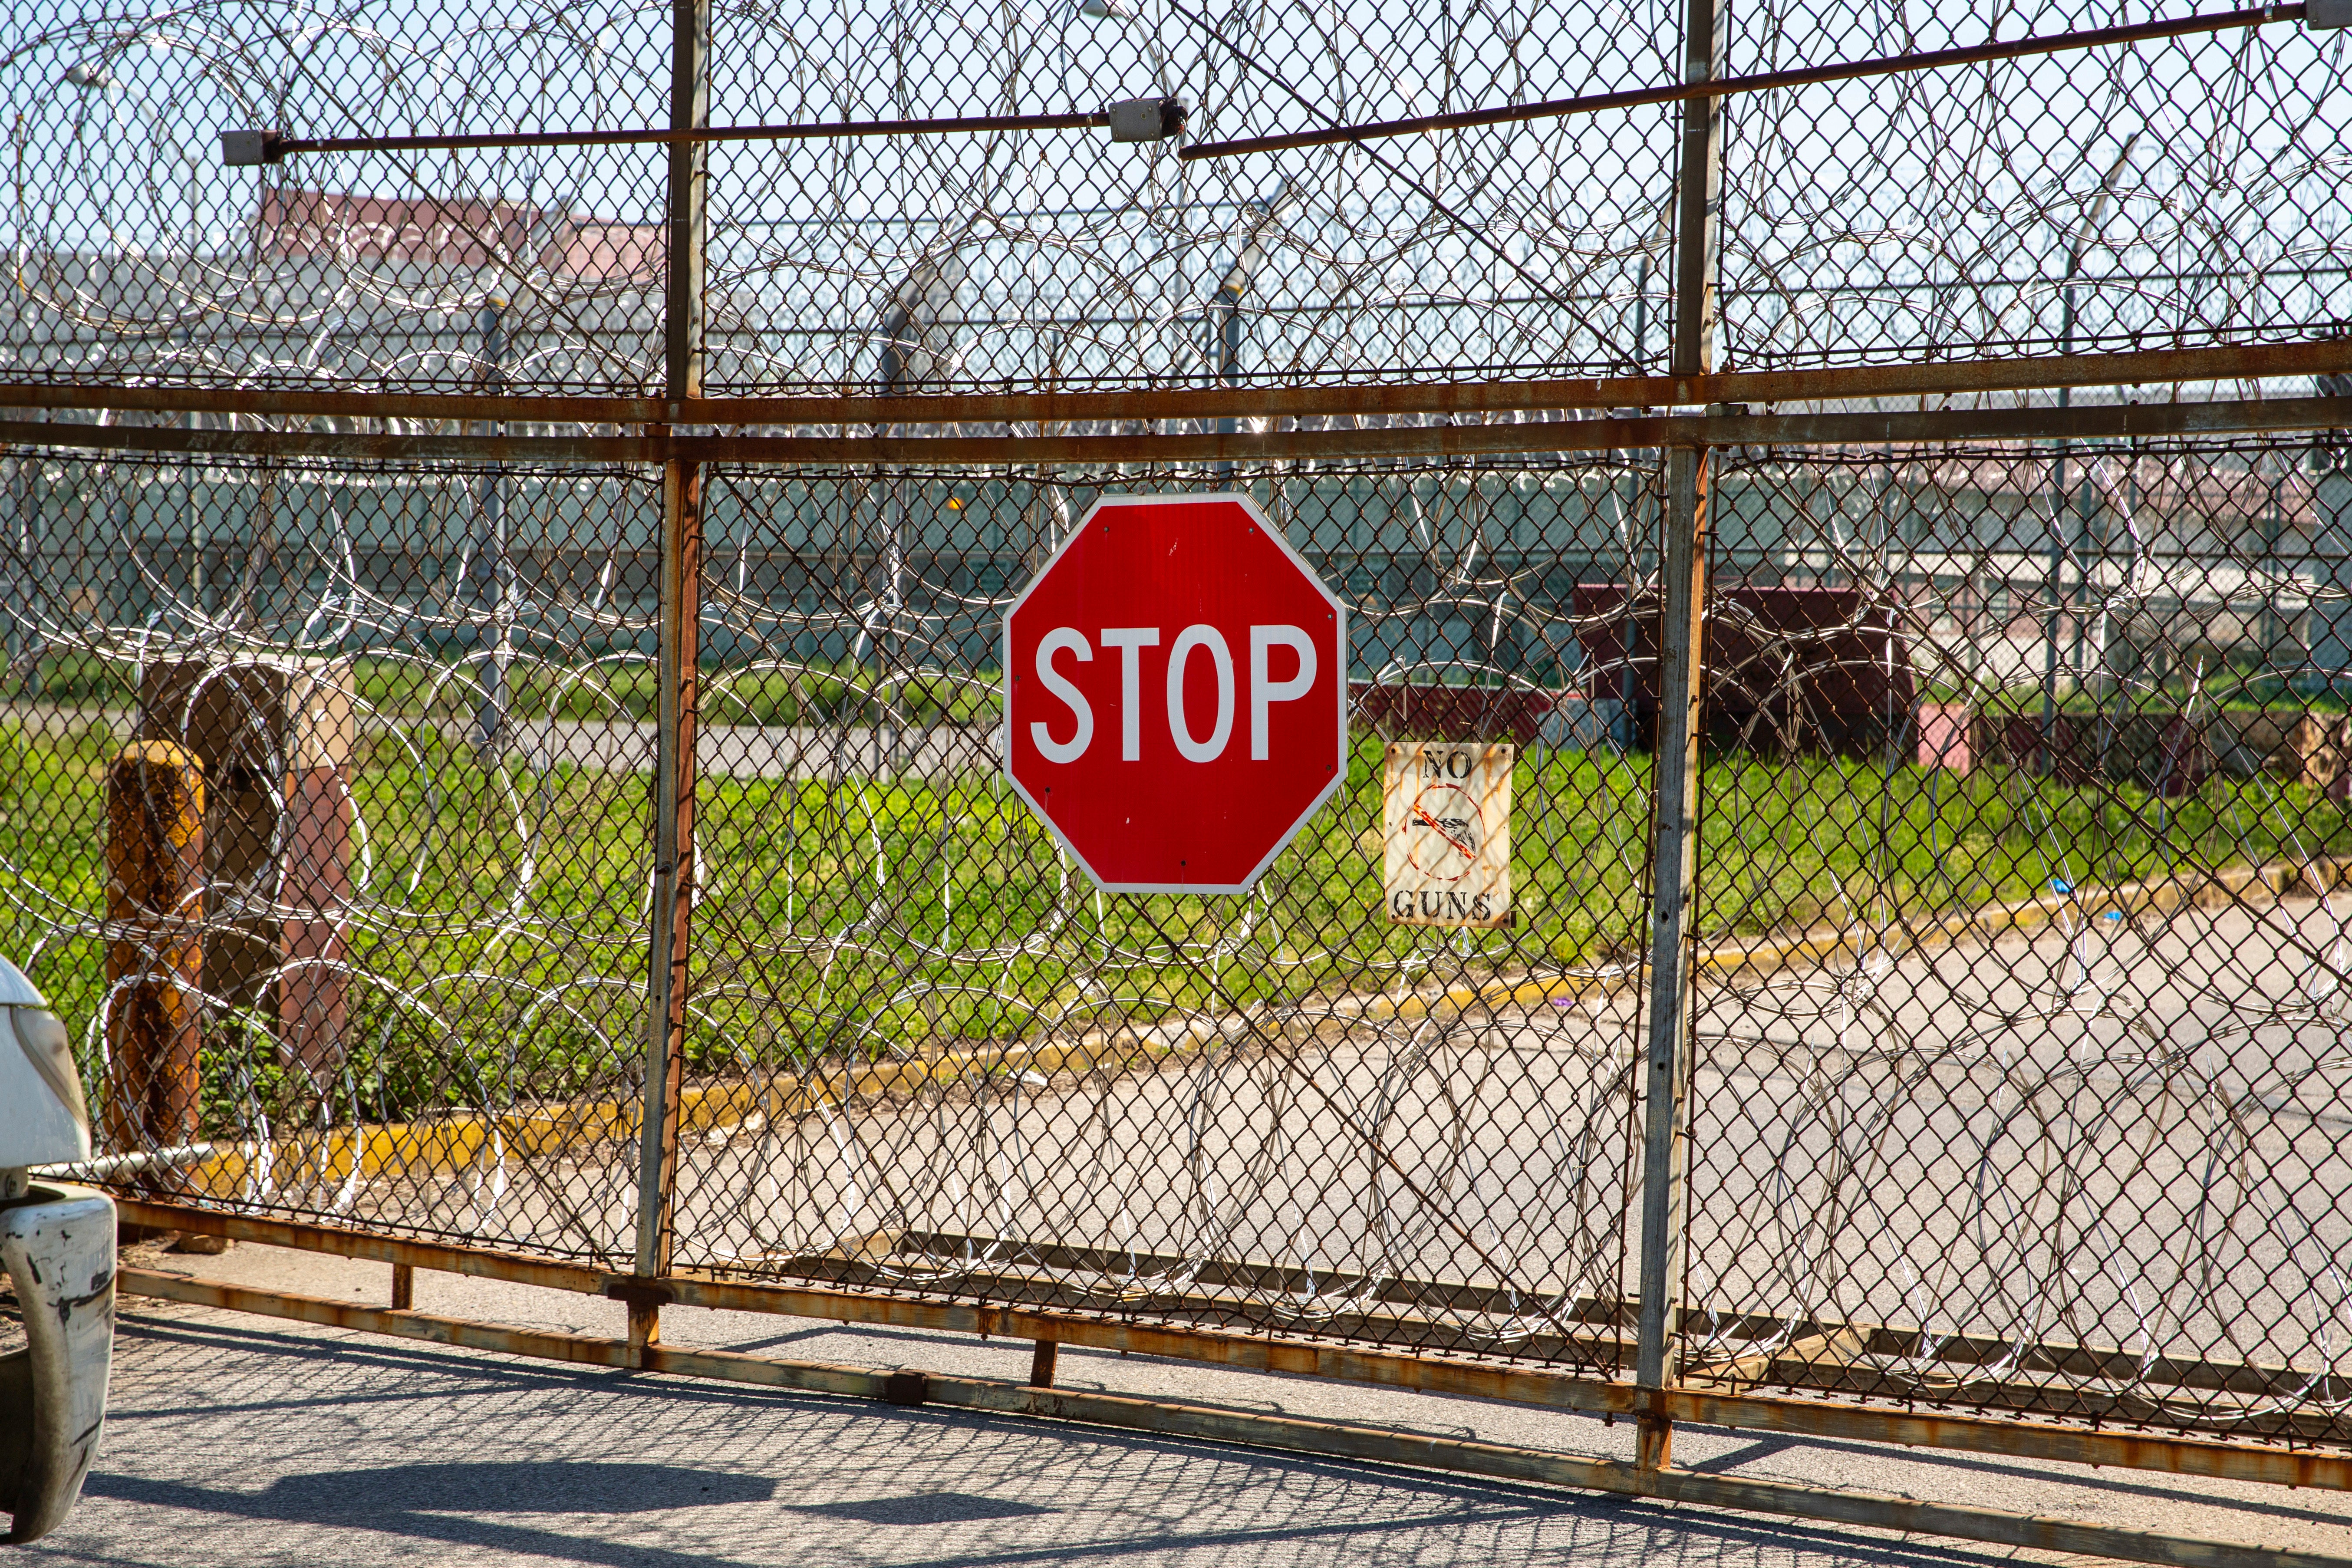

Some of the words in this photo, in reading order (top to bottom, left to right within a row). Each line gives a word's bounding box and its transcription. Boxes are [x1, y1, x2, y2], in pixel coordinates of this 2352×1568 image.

[1031, 624, 1317, 764] STOP
[1423, 750, 1472, 778] NO
[1393, 890, 1491, 921] GUNS
